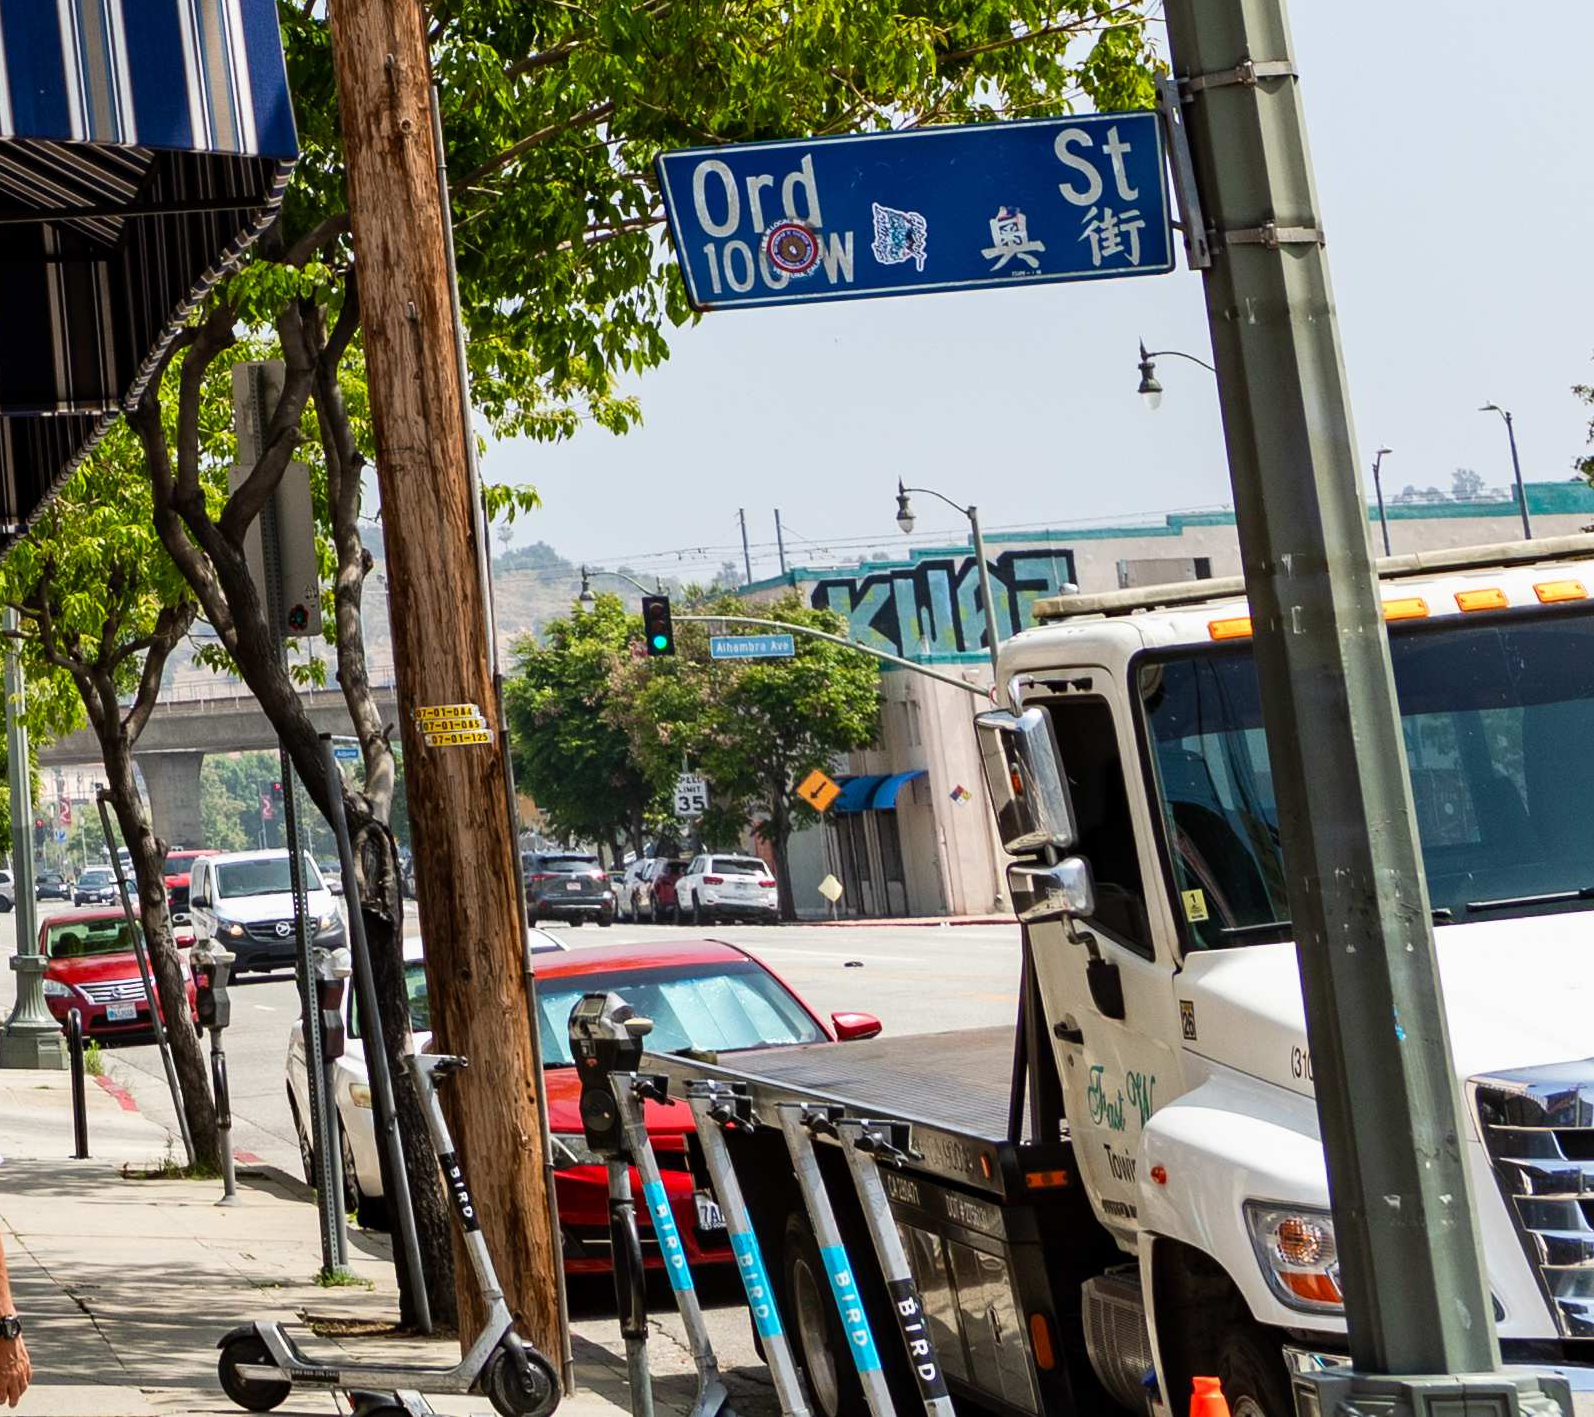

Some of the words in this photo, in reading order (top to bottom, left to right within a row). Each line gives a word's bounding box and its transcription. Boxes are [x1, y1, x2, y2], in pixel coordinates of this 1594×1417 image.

[692, 152, 824, 237] Ord
[1052, 124, 1140, 207] St
[821, 230, 855, 285] W
[1076, 205, 1147, 268] 街
[716, 641, 767, 654] Alhambra
[769, 640, 790, 652] Ave
[678, 795, 706, 813] 35
[450, 1166, 474, 1218] BIRD
[656, 1203, 684, 1269] BIRD
[739, 1252, 769, 1319] BIRD
[834, 1269, 868, 1346] BIRD
[898, 1296, 936, 1381] BIRD
